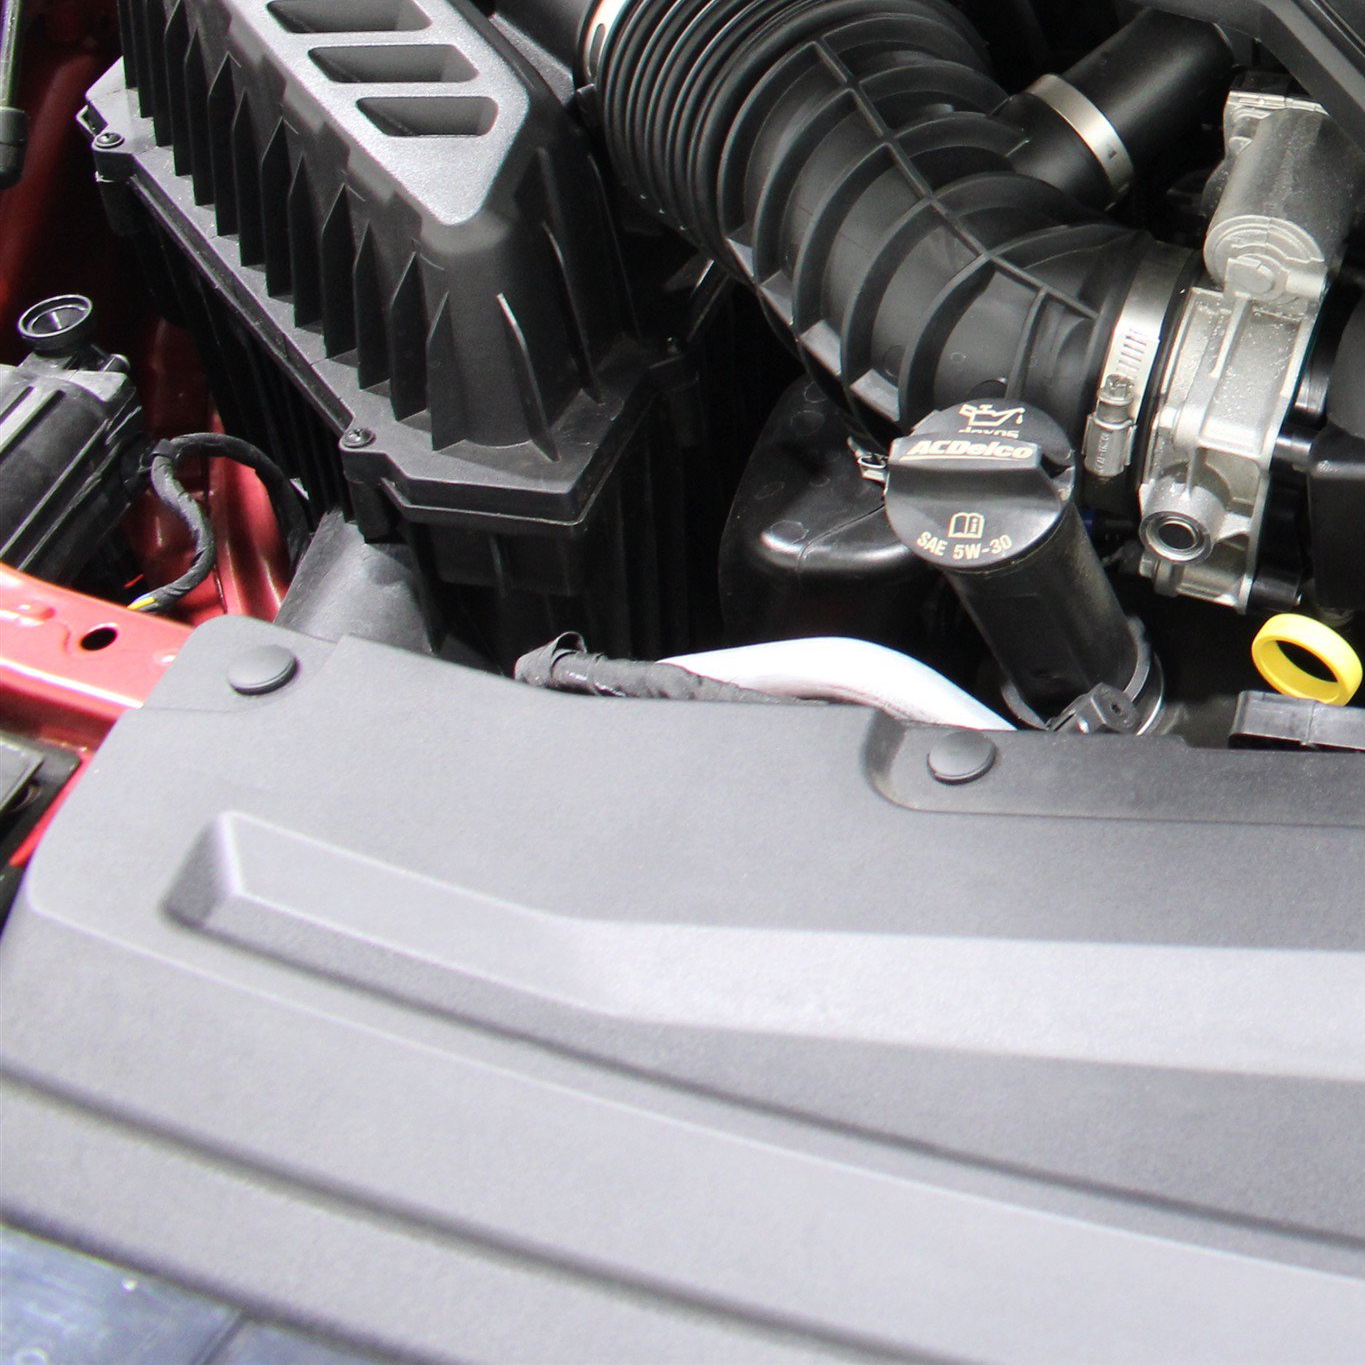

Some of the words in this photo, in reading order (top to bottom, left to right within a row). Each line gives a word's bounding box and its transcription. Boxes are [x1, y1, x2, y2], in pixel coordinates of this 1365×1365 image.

[906, 440, 1033, 460] ACDelco
[916, 530, 949, 557] SAE
[953, 534, 1013, 560] 5W-30
